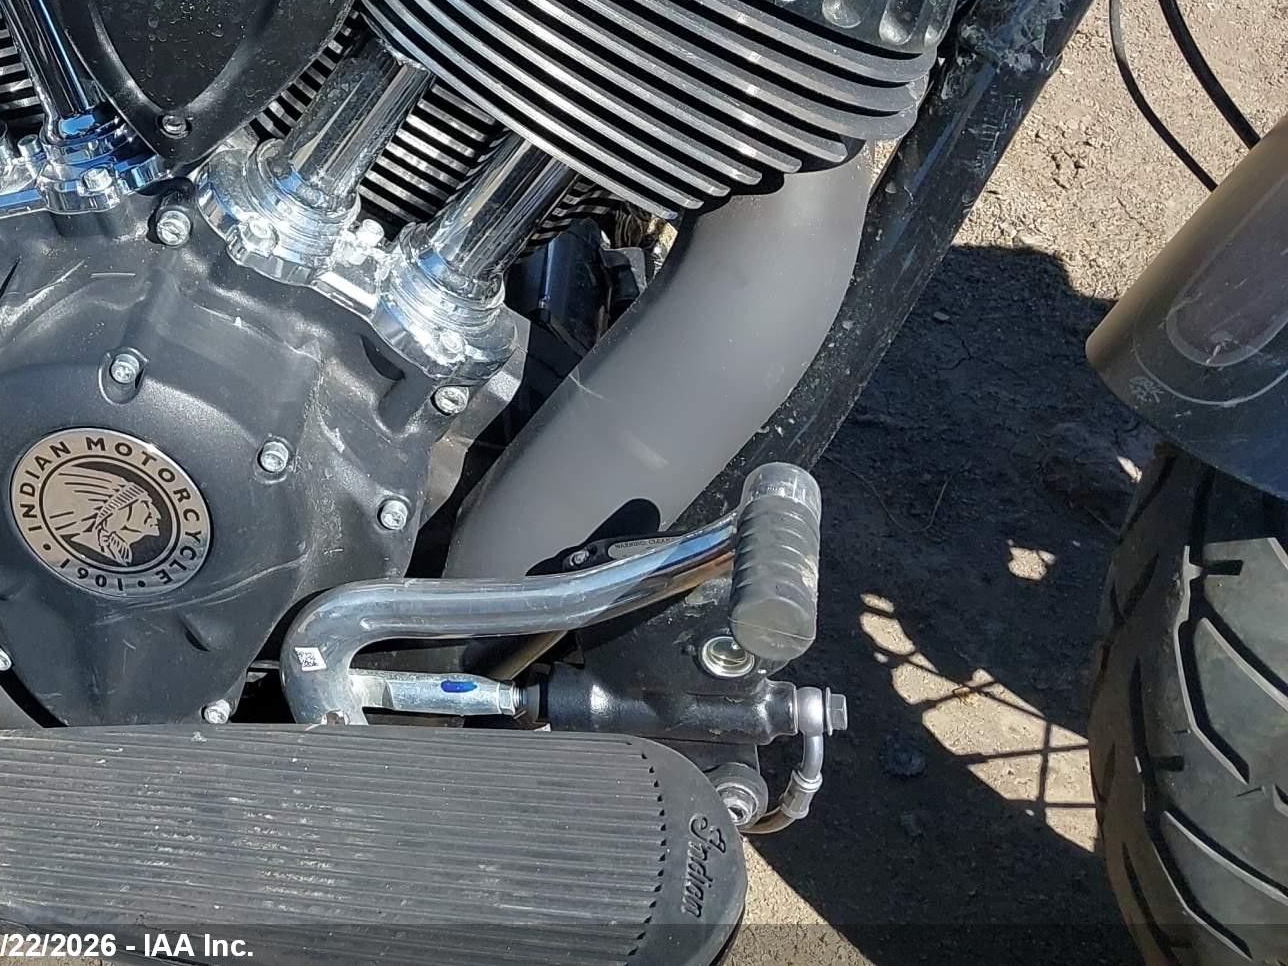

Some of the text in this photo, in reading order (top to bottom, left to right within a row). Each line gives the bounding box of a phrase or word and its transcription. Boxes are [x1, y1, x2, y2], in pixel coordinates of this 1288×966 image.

[19, 437, 202, 585] INDIAN MOTORCYCLE
[60, 558, 124, 592] 1901
[680, 814, 727, 918] Indian
